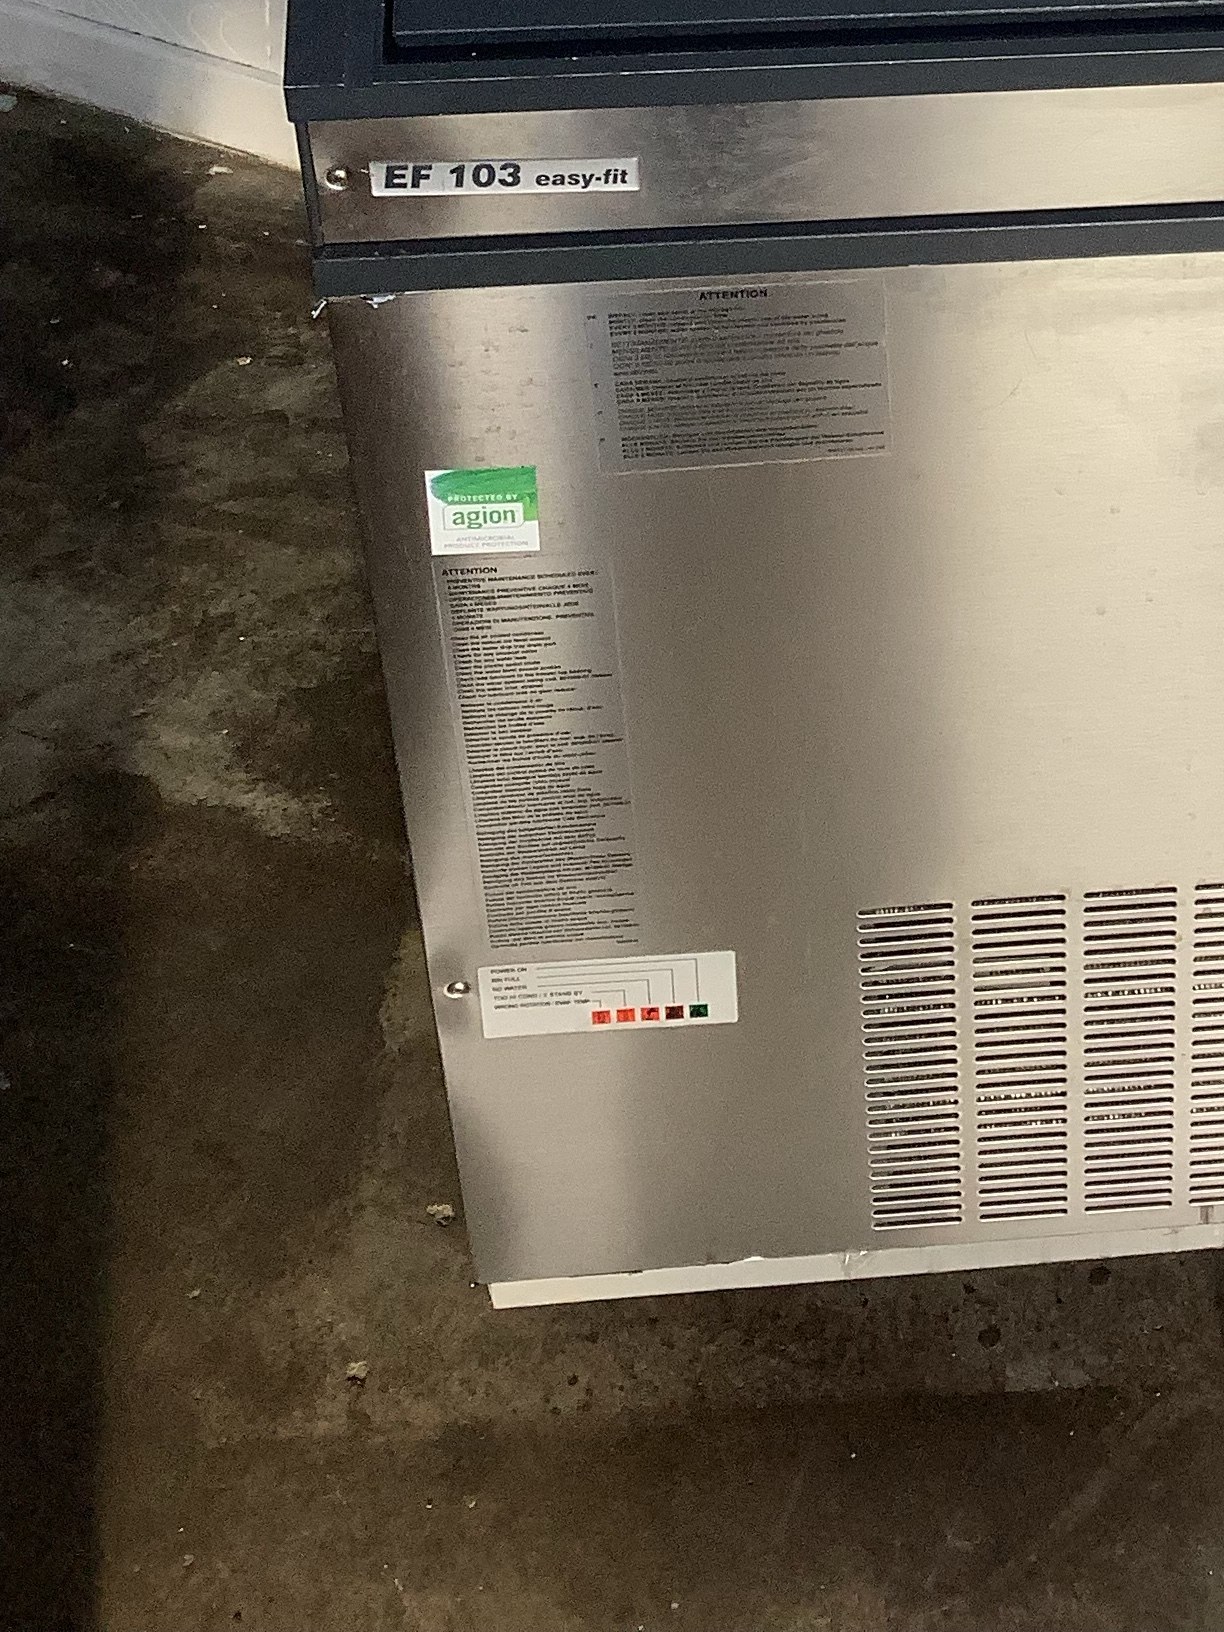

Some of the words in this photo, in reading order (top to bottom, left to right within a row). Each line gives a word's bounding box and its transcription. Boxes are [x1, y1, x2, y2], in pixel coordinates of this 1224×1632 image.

[384, 164, 433, 189] EF
[449, 163, 521, 188] 103
[535, 169, 629, 189] easy-fit
[699, 288, 768, 301] ATTENTION
[447, 494, 503, 502] PROTECTED
[452, 506, 516, 530] agion
[441, 567, 498, 577] ATTENTION
